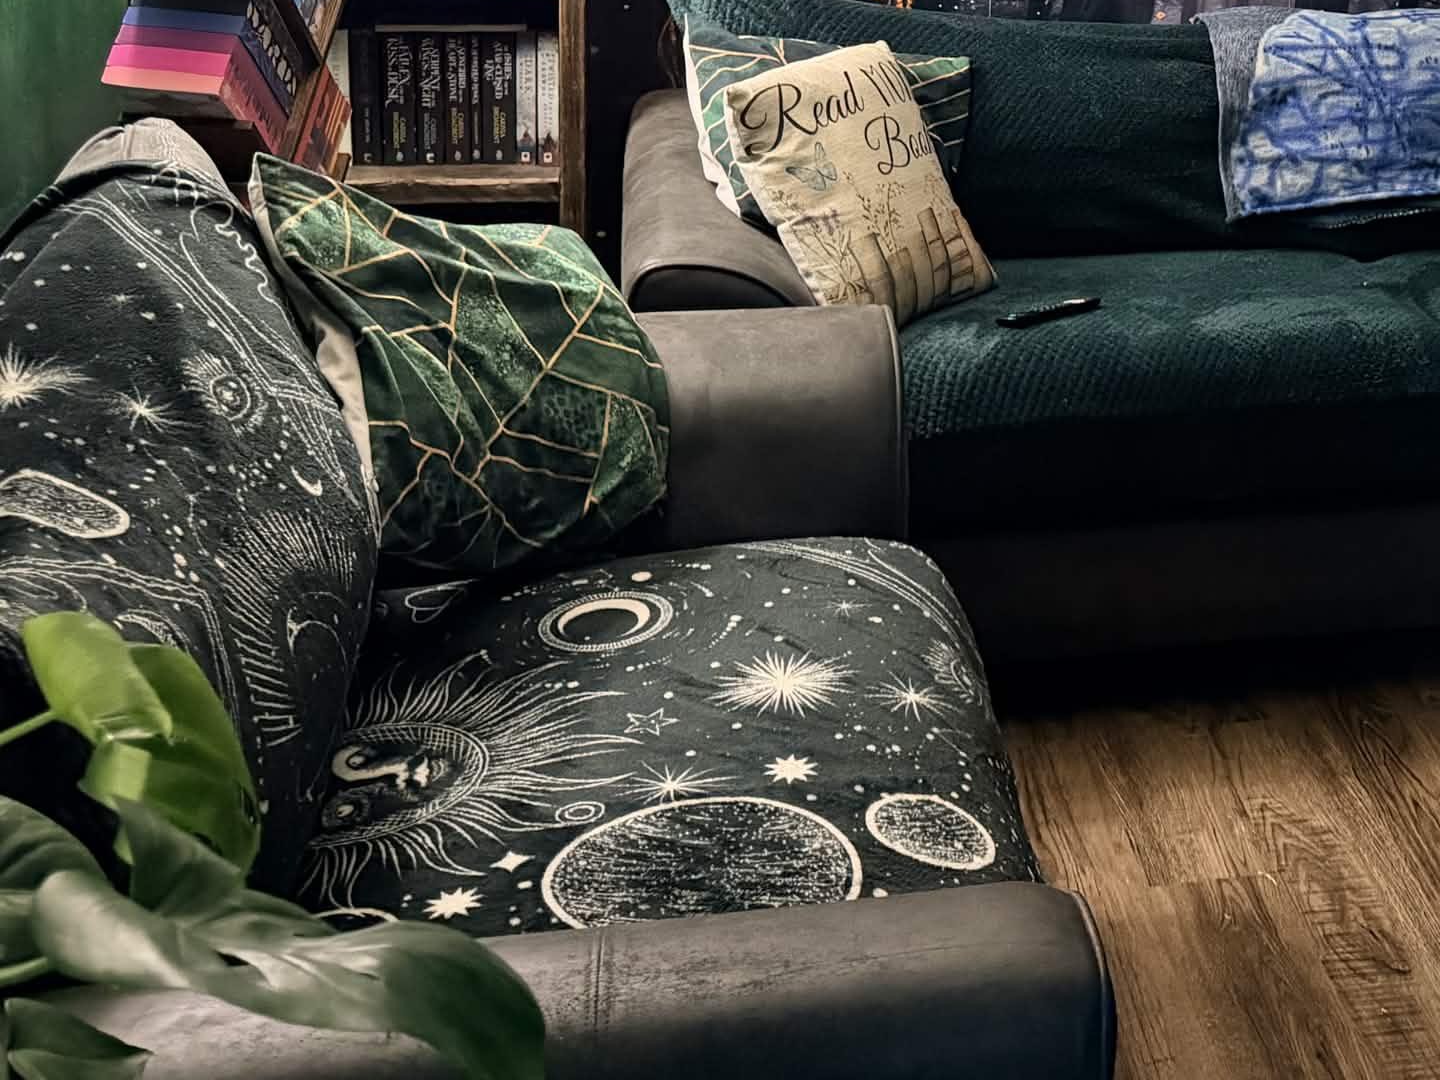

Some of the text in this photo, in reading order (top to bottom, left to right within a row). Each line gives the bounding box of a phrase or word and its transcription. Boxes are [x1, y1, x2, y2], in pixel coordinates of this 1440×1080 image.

[429, 48, 442, 91] SERPENT
[446, 71, 458, 101] STONE
[523, 58, 534, 93] DARK
[418, 73, 435, 108] NIGHT
[739, 70, 866, 157] Read
[864, 111, 934, 176] Boo
